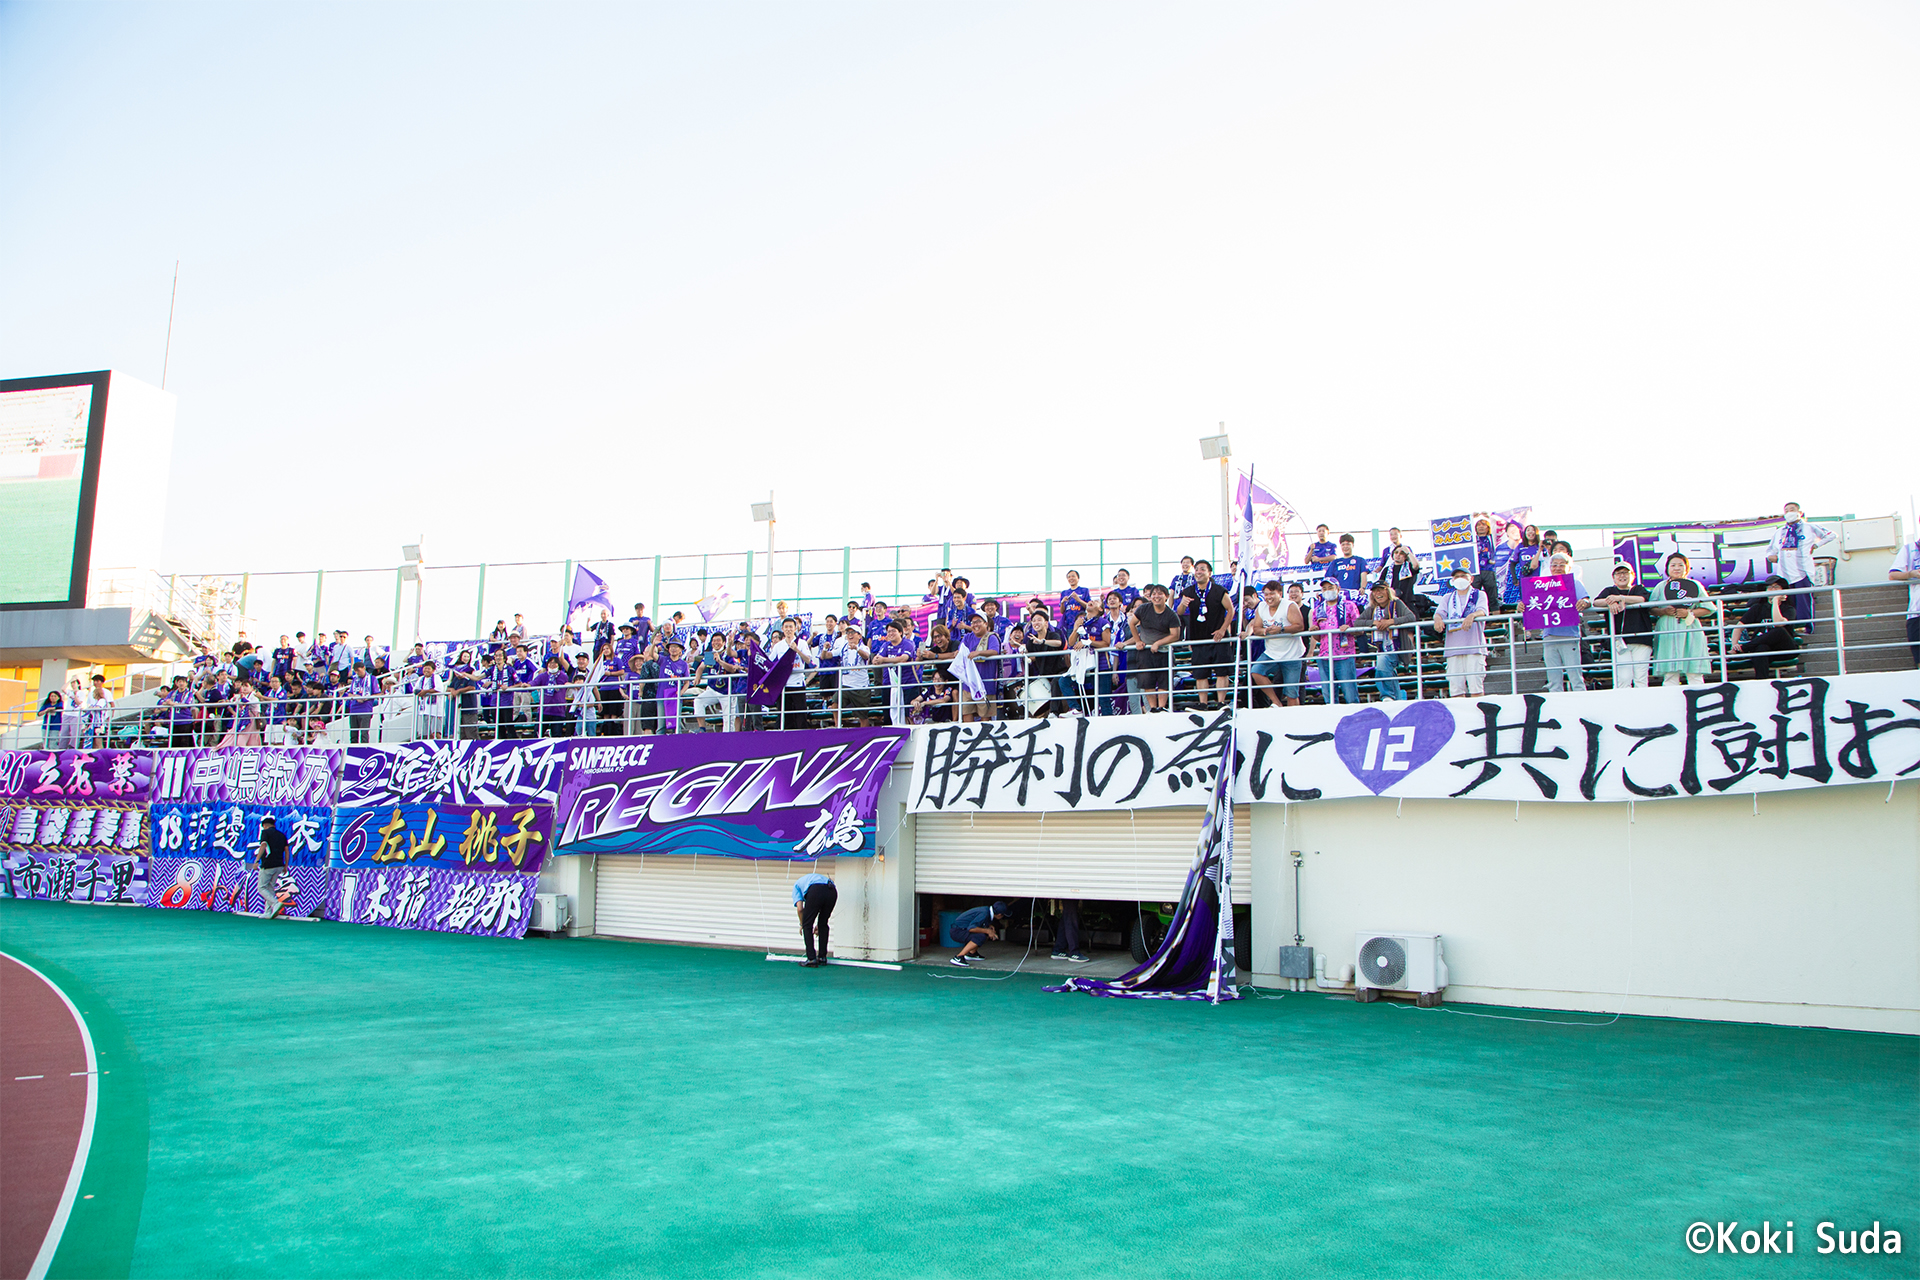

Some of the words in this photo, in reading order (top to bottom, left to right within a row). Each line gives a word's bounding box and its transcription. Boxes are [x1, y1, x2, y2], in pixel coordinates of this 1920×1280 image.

[1434, 530, 1472, 545] みんなで
[1343, 572, 1349, 581] 9
[1533, 578, 1563, 592] Regina
[1542, 611, 1562, 626] 13
[568, 743, 654, 771] SANFRECCE
[1362, 725, 1416, 771] 12
[161, 756, 187, 799] 11
[340, 752, 388, 799] 2
[558, 735, 905, 848] REGINA
[158, 814, 184, 850] 18
[339, 810, 376, 866] 6
[371, 807, 447, 864] 左山
[458, 807, 544, 867] 桃子
[159, 861, 204, 908] 8
